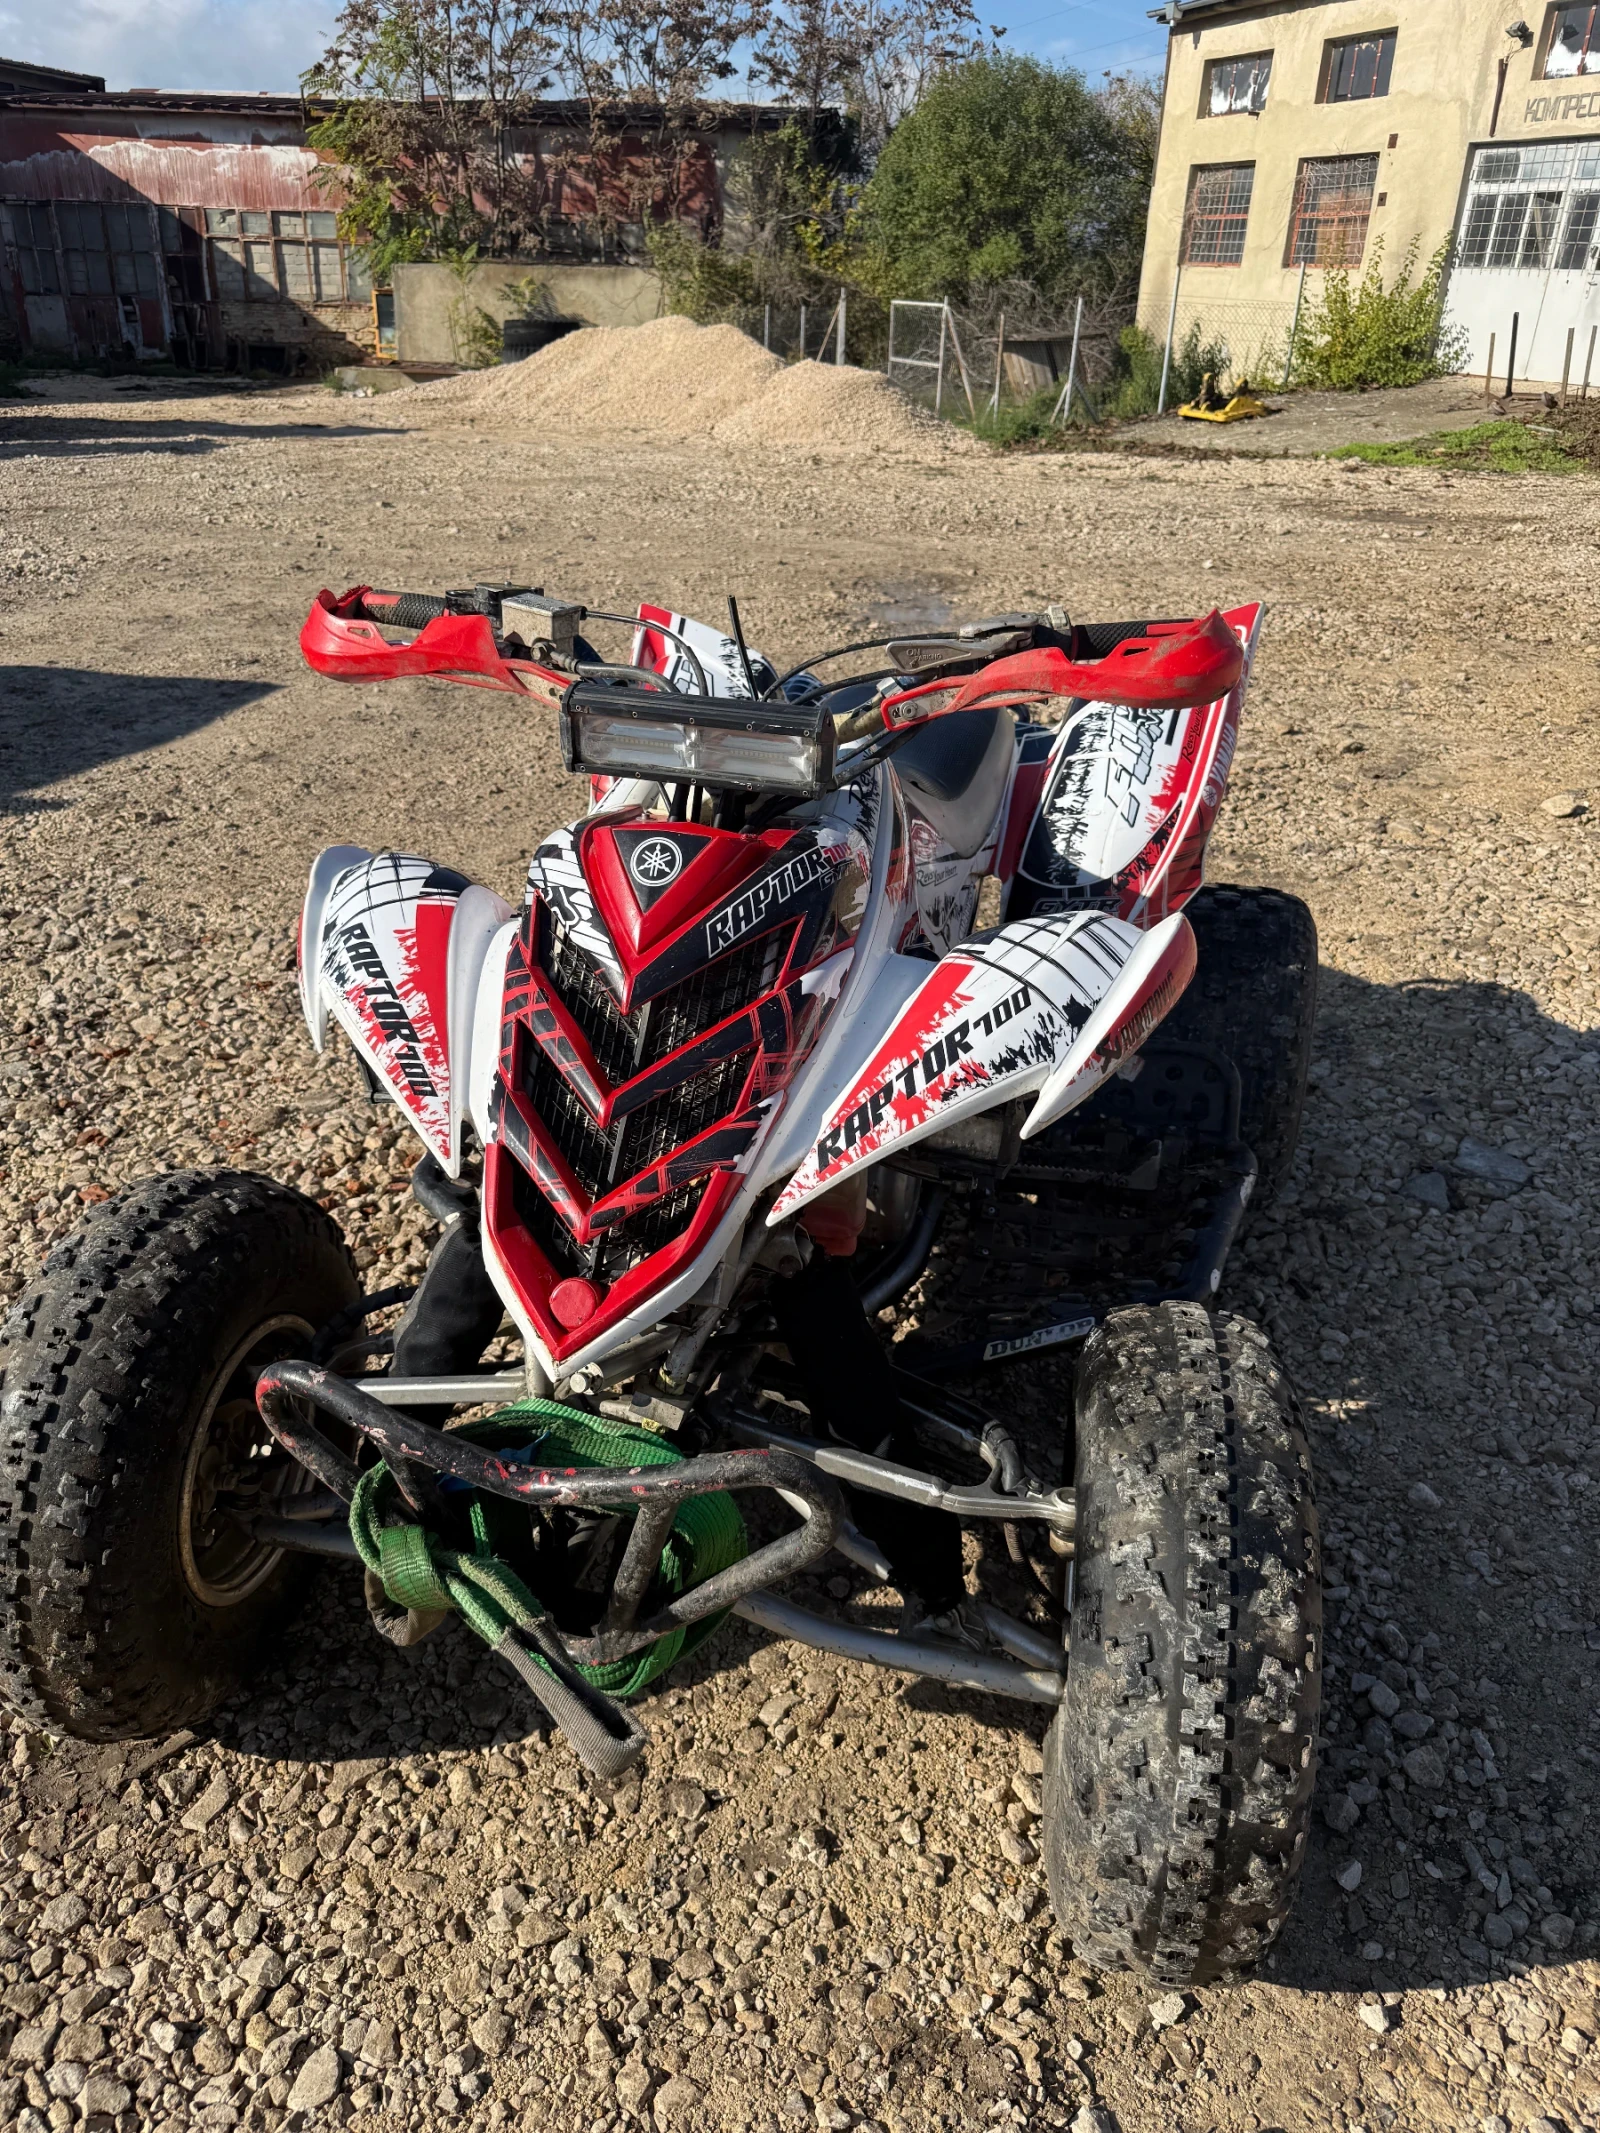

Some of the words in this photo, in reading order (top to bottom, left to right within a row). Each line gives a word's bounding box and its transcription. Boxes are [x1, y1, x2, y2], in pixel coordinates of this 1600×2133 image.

[1523, 91, 1600, 123] КОМПРЕС
[906, 648, 921, 656] ON
[1209, 722, 1237, 787] YAMAHA
[707, 845, 831, 959] RAPTOR
[339, 922, 421, 1043] RAPTOR
[395, 1045, 438, 1097] 700
[816, 1019, 975, 1173] RAPTOR
[973, 987, 1031, 1037] 700
[989, 1321, 1092, 1357] DUNOP
